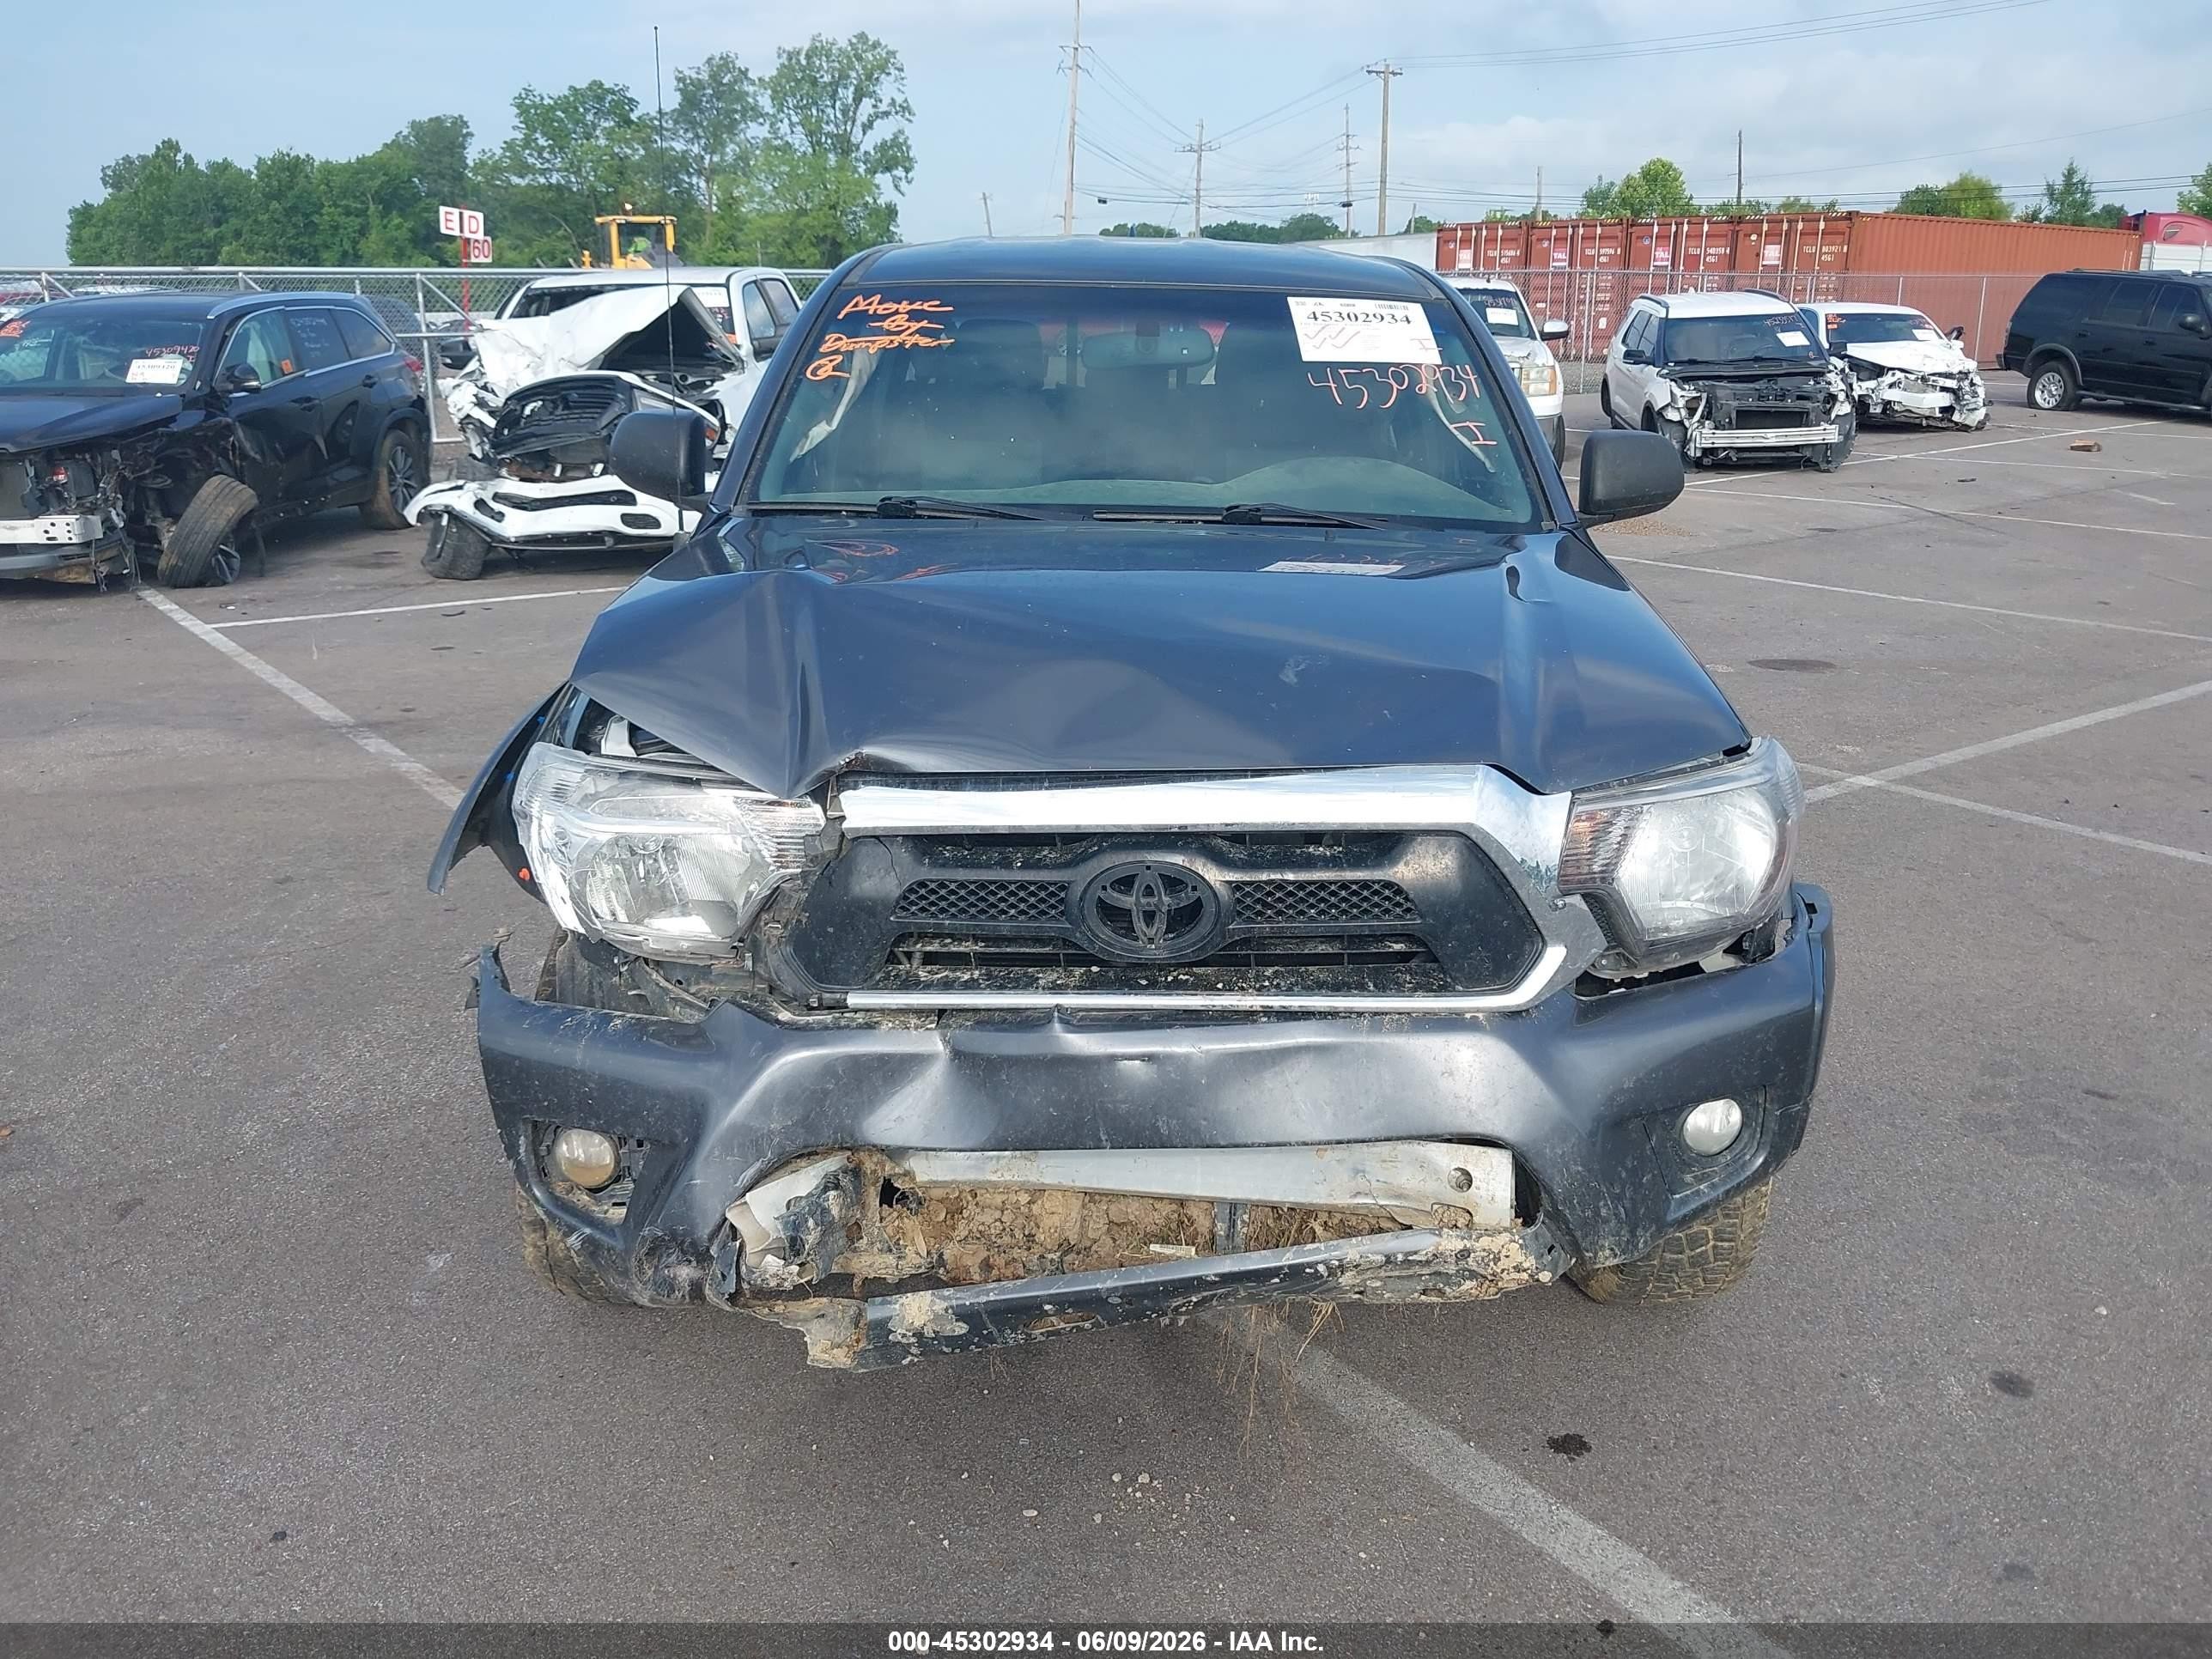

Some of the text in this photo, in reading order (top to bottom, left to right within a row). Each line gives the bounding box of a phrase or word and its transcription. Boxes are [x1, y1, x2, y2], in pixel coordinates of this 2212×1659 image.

[444, 211, 480, 234] E D
[472, 239, 491, 258] 60
[1307, 310, 1412, 325] 45302934
[145, 345, 200, 357] 45309420
[1307, 363, 1479, 410] 45302934
